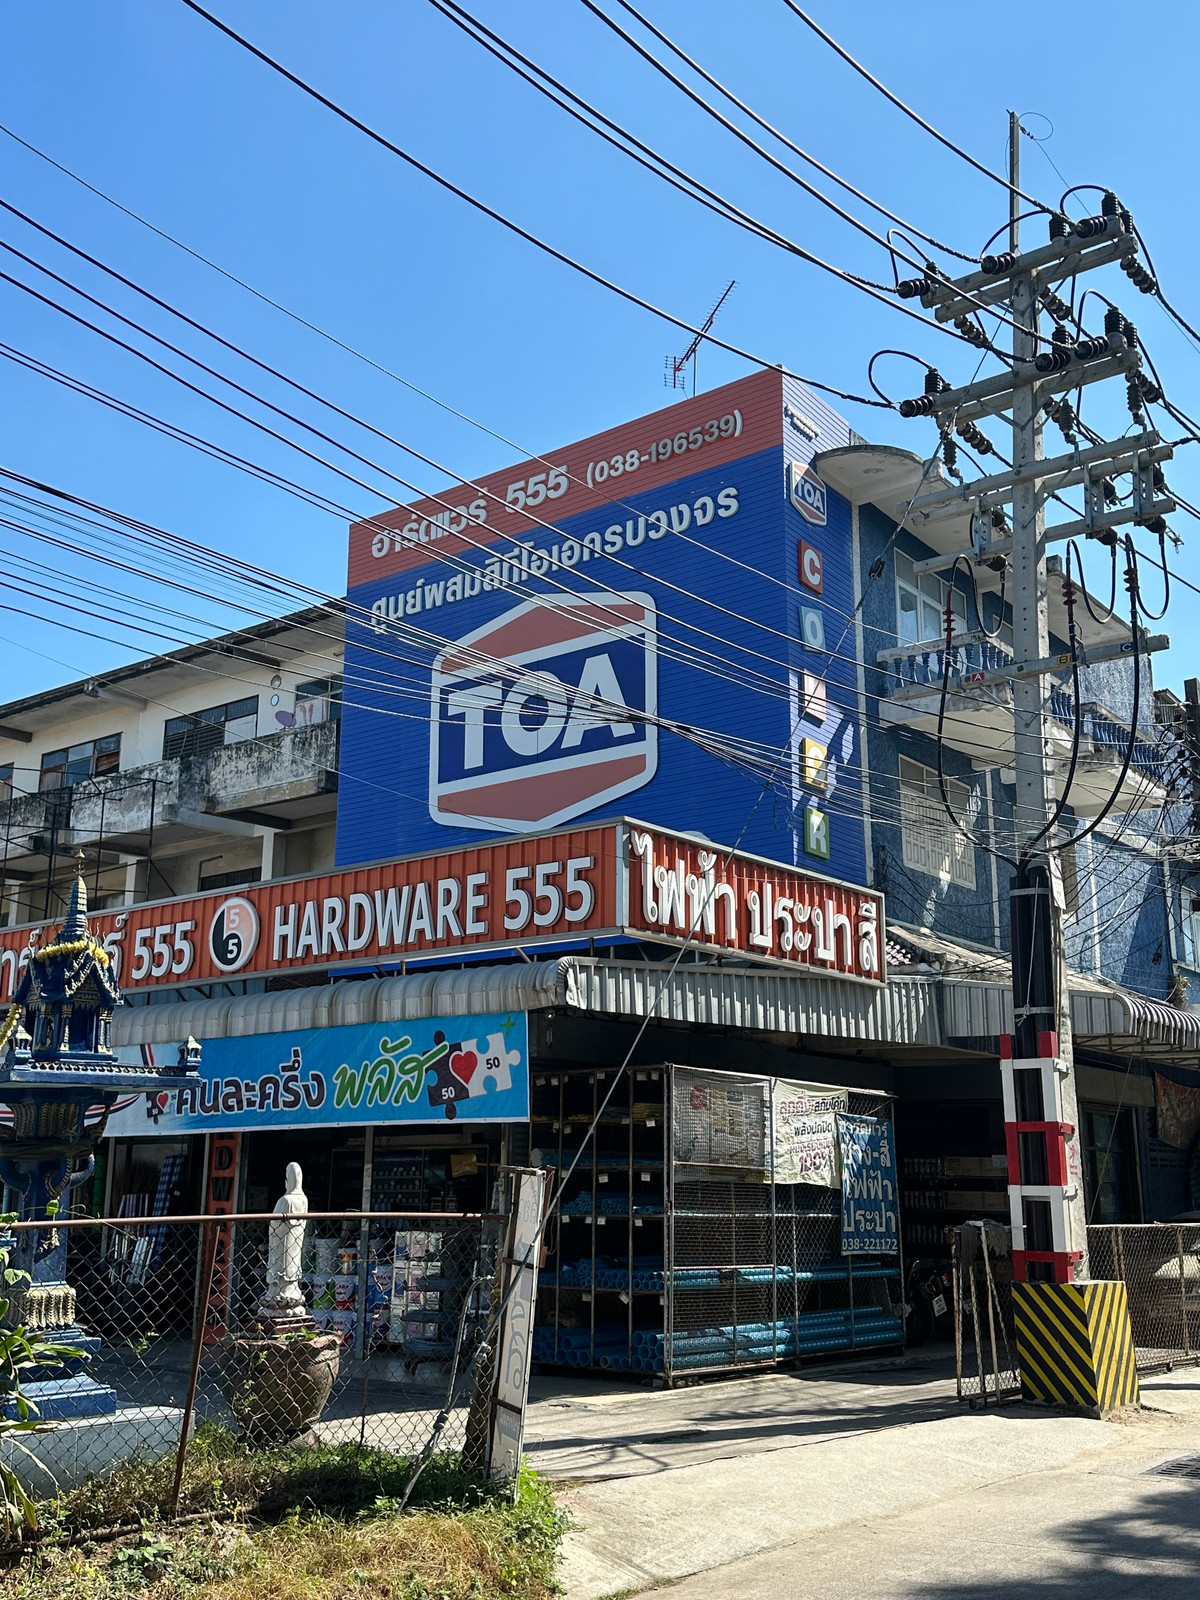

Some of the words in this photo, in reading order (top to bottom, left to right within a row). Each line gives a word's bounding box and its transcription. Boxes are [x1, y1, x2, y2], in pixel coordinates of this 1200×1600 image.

[505, 464, 569, 513] 555
[586, 409, 743, 488] (038-196539)
[794, 472, 824, 513] TOA
[447, 652, 636, 770] TOA
[273, 871, 489, 962] HARDWARE
[503, 855, 596, 931] 555
[631, 830, 737, 941] ไฟฟ้า
[746, 881, 853, 966] ประปา
[858, 901, 879, 973] สี
[132, 920, 197, 981] 555
[176, 1048, 326, 1116] คนละครึ่ง
[332, 1036, 450, 1107] พลัส
[441, 1086, 455, 1100] 50
[486, 1056, 500, 1070] 50
[842, 1238, 898, 1251] 038-221172
[843, 1201, 896, 1233] ประปา
